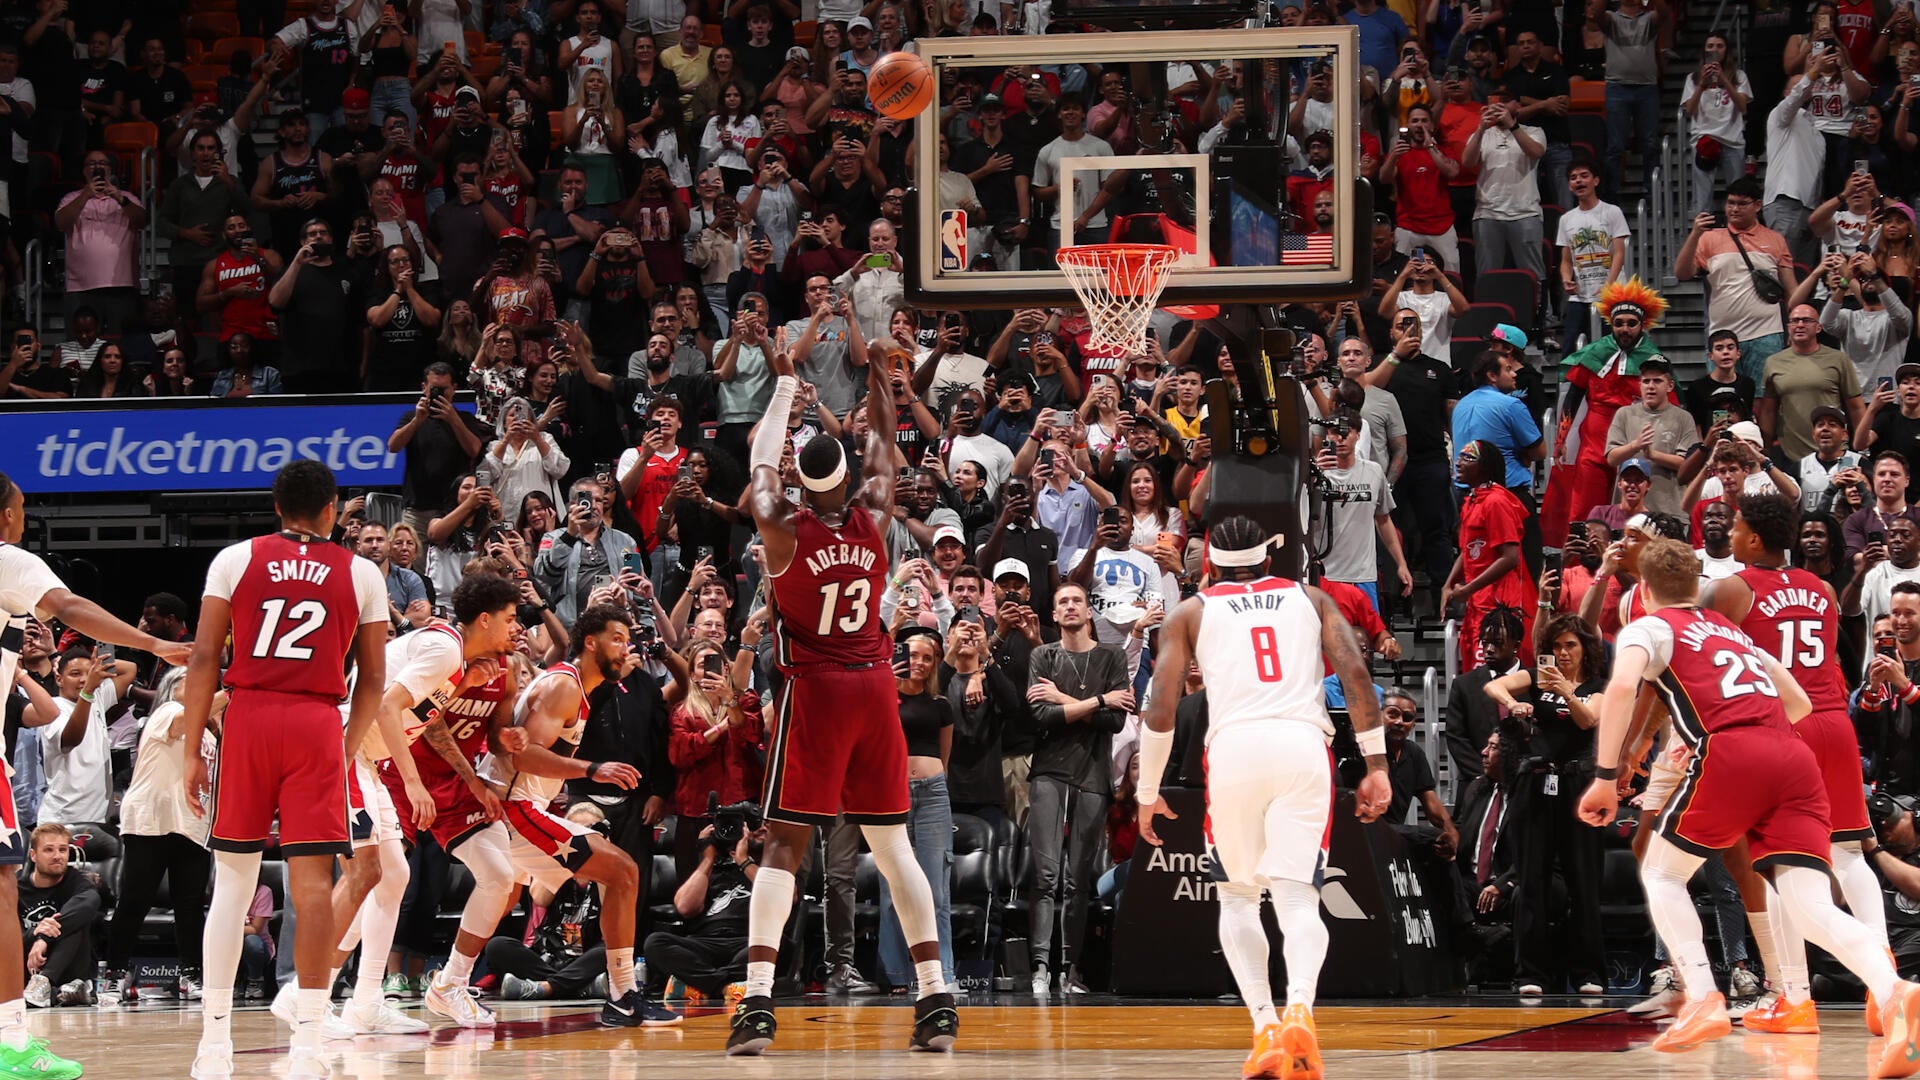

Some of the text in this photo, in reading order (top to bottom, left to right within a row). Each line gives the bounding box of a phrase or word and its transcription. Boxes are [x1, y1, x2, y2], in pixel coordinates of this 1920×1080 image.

[1812, 95, 1843, 117] 14
[381, 165, 417, 176] MIAMI
[944, 257, 957, 268] NBA
[492, 289, 529, 310] HEAT
[37, 427, 399, 478] ticketmaster
[267, 560, 331, 586] SMITH
[805, 543, 877, 577] ADEBAYO
[817, 578, 872, 636] 13
[1227, 595, 1286, 614] HARDY
[1758, 588, 1829, 617] GARDNER
[252, 598, 328, 661] 12
[1250, 626, 1282, 682] 8
[1777, 620, 1825, 670] 15
[1713, 648, 1779, 699] 25
[1540, 692, 1555, 703] EL
[450, 719, 482, 740] 16
